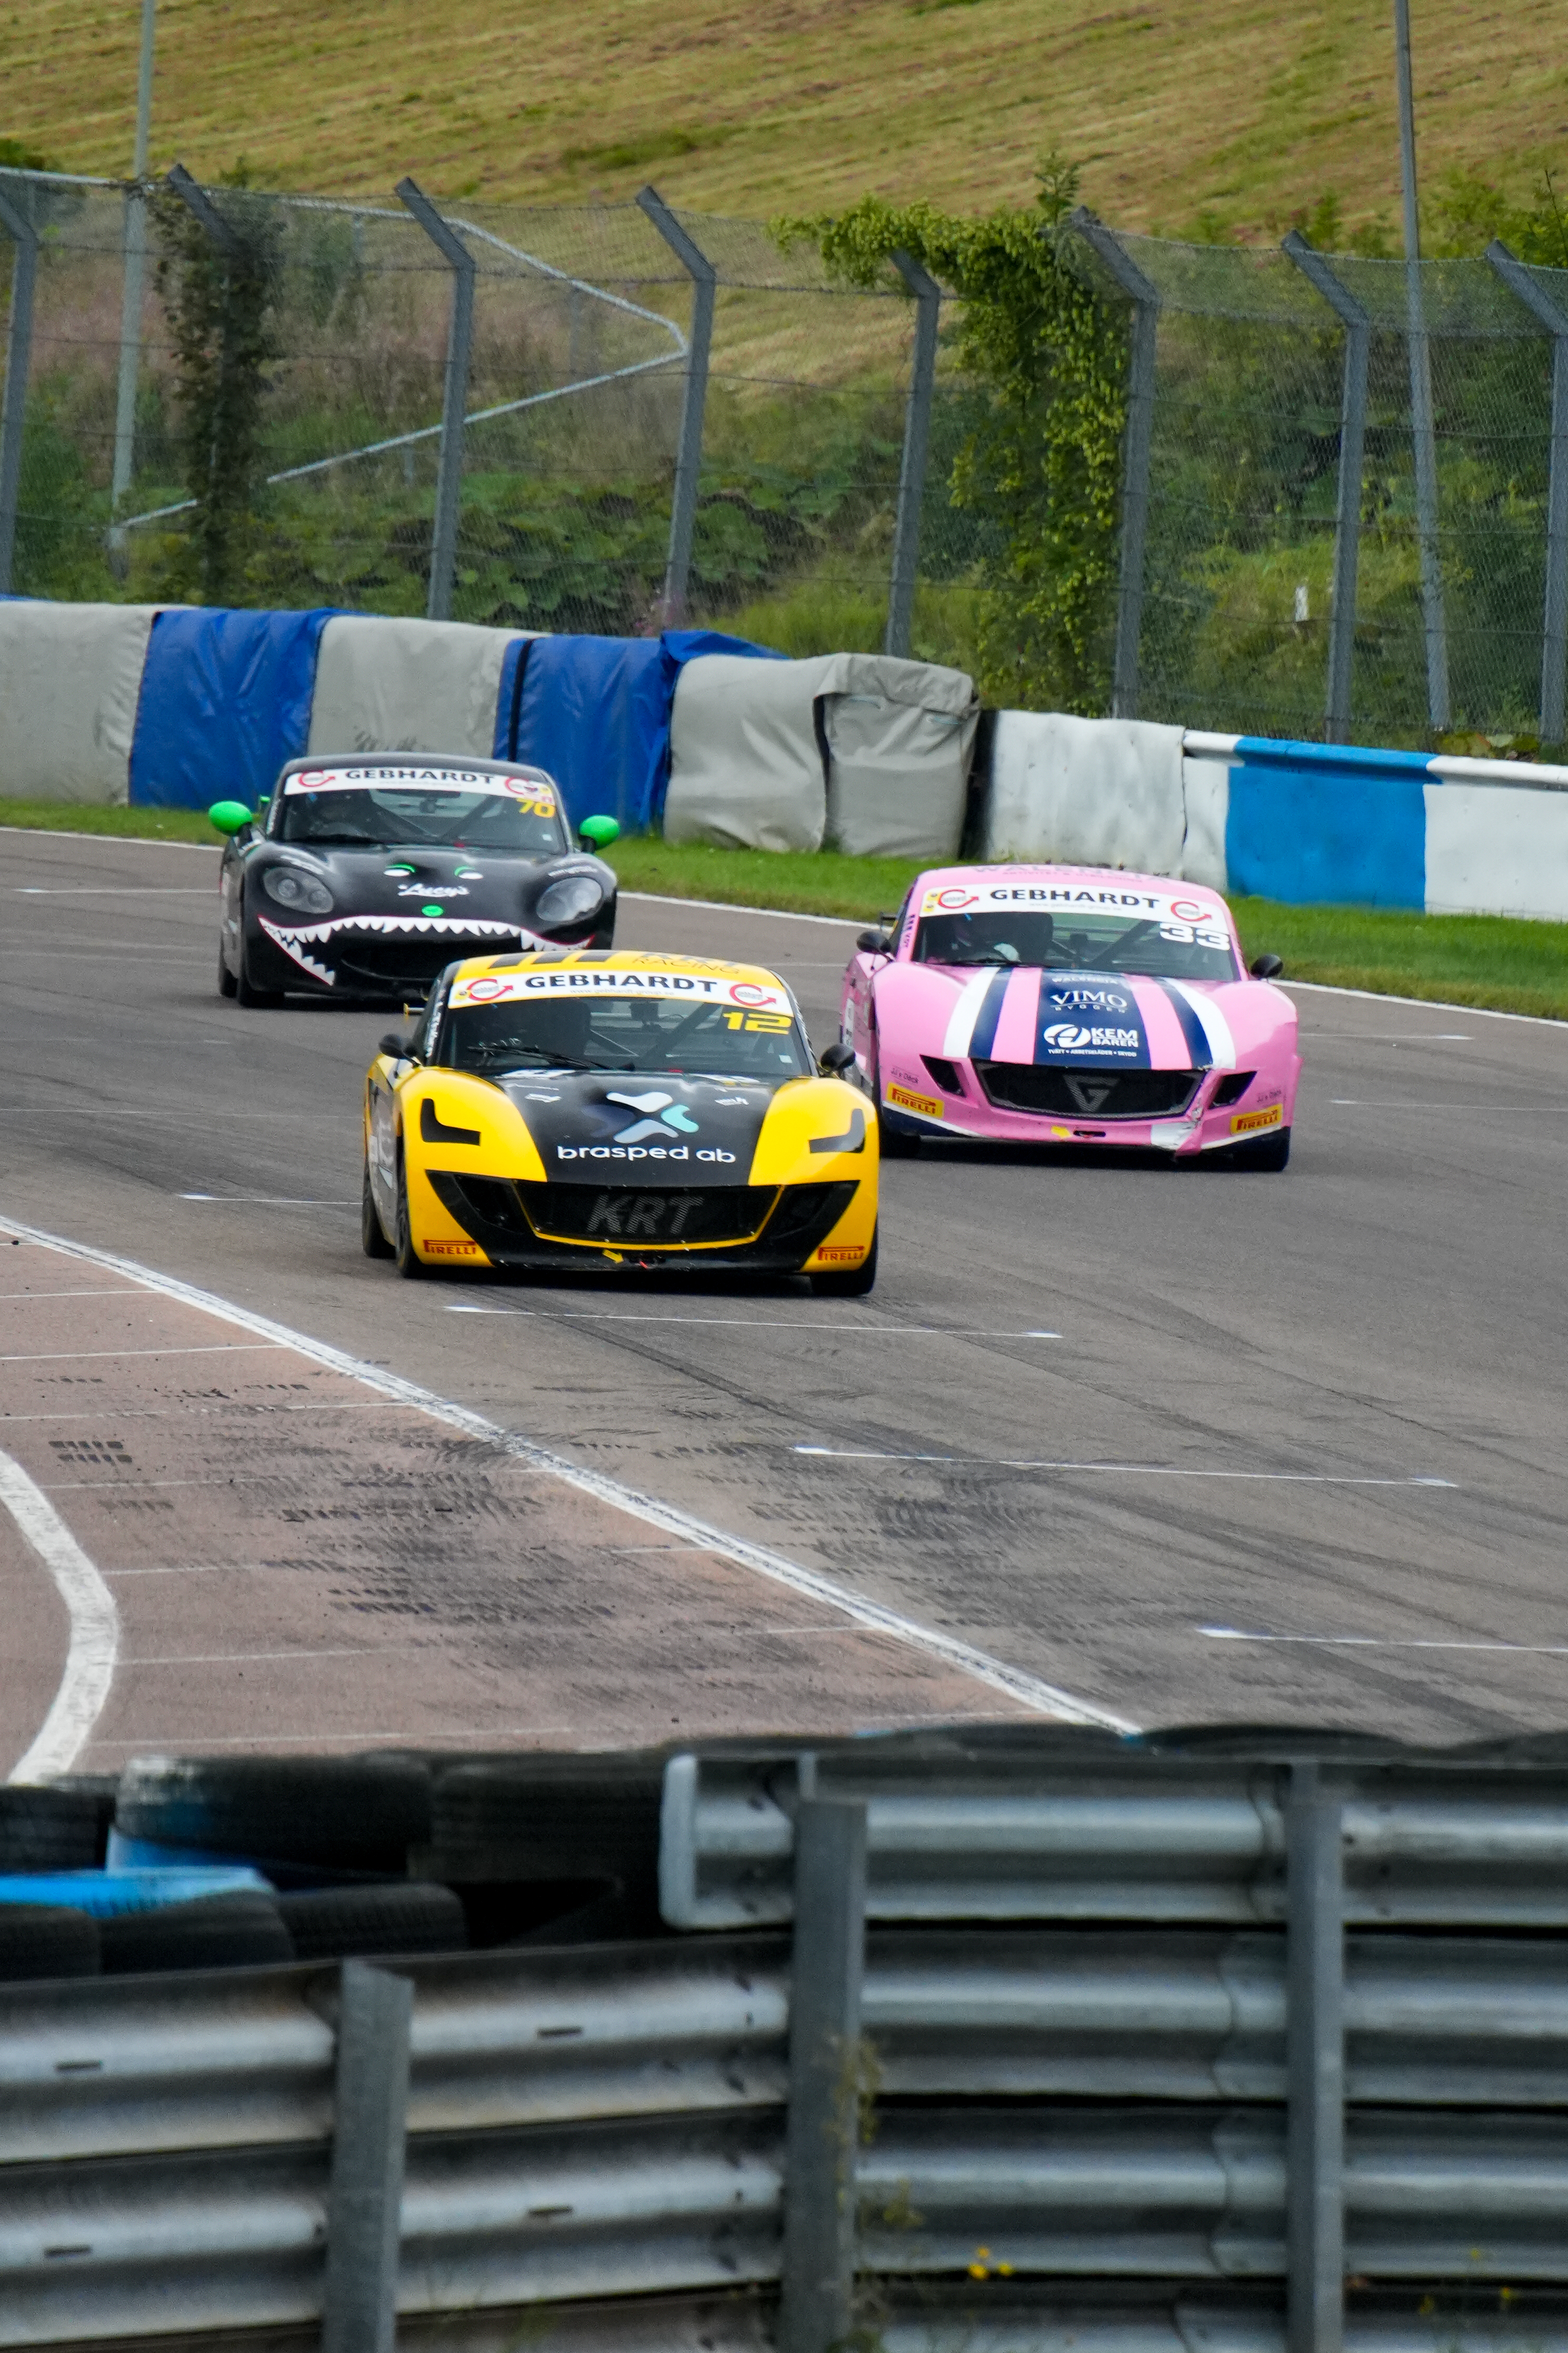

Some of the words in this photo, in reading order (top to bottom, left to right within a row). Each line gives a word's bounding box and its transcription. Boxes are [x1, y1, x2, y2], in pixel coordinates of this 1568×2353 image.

[345, 770, 494, 785] GEBHARDT
[515, 797, 556, 819] 70
[990, 889, 1160, 909] GEBHARDT
[1159, 922, 1230, 951] 33
[632, 957, 740, 974] RACING
[525, 974, 718, 993] GEBHARDT
[1050, 990, 1128, 1008] VIMO
[721, 1011, 792, 1035] 12
[1090, 1027, 1138, 1040] KEM
[1091, 1039, 1139, 1048] BAREN
[892, 1087, 936, 1114] PIRELLI
[1236, 1109, 1278, 1131] PIRELLI
[557, 1145, 689, 1161] brasped
[696, 1148, 736, 1163] ab
[586, 1195, 705, 1234] KRT
[422, 1239, 476, 1254] PIRELLI
[818, 1245, 864, 1261] PIRELLI
